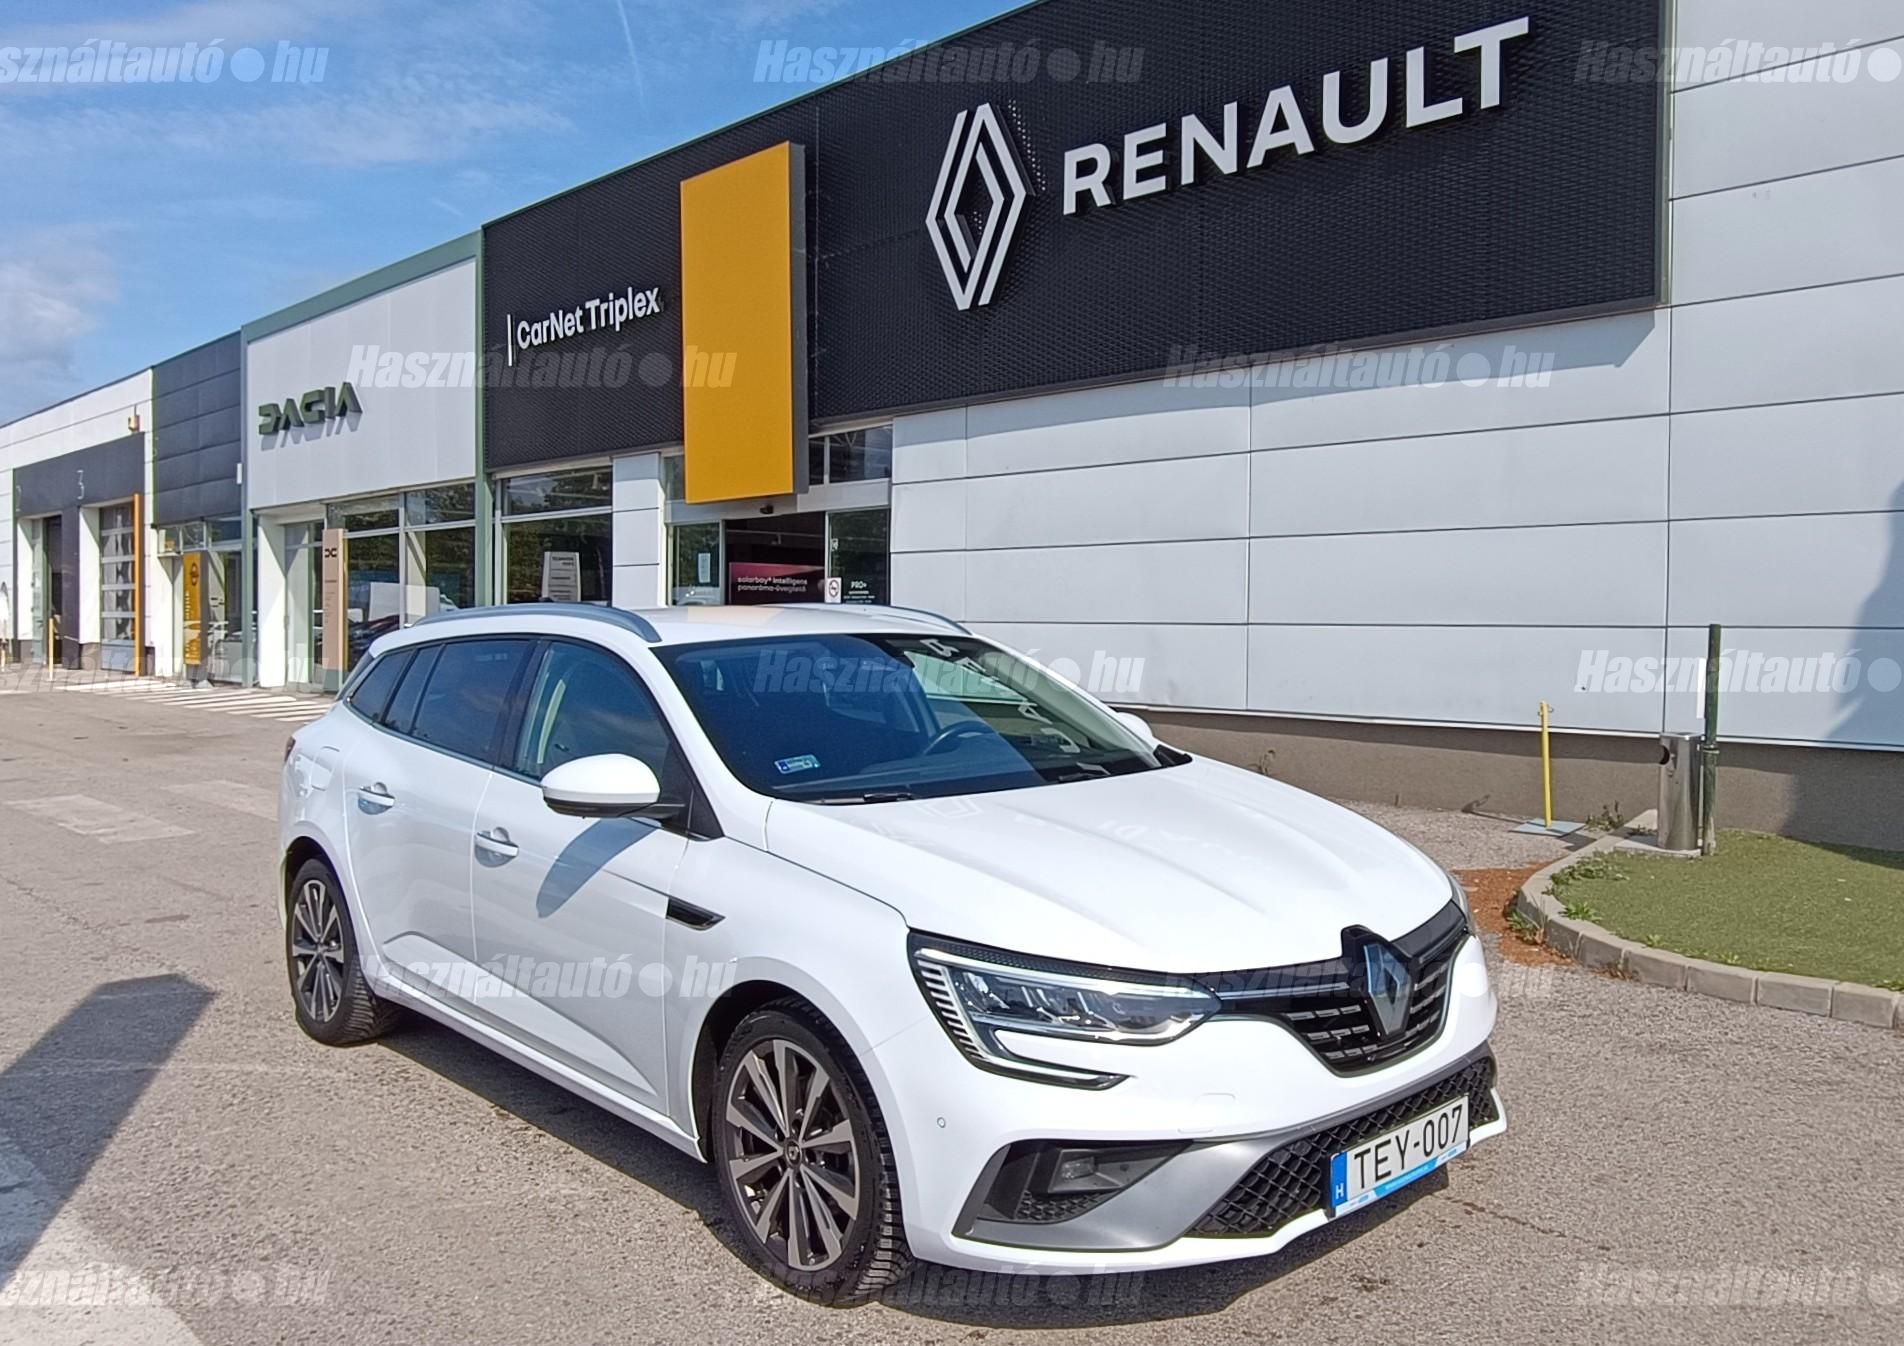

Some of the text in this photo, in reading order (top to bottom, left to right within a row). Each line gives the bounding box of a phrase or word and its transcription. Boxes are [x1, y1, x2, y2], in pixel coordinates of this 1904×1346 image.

[1063, 16, 1529, 215] RENAULT
[517, 286, 660, 350] CarNet Triplex
[258, 381, 363, 436] DACIA
[76, 469, 84, 500] 3
[1354, 1103, 1463, 1190] TEY-007
[1335, 1182, 1345, 1200] H
